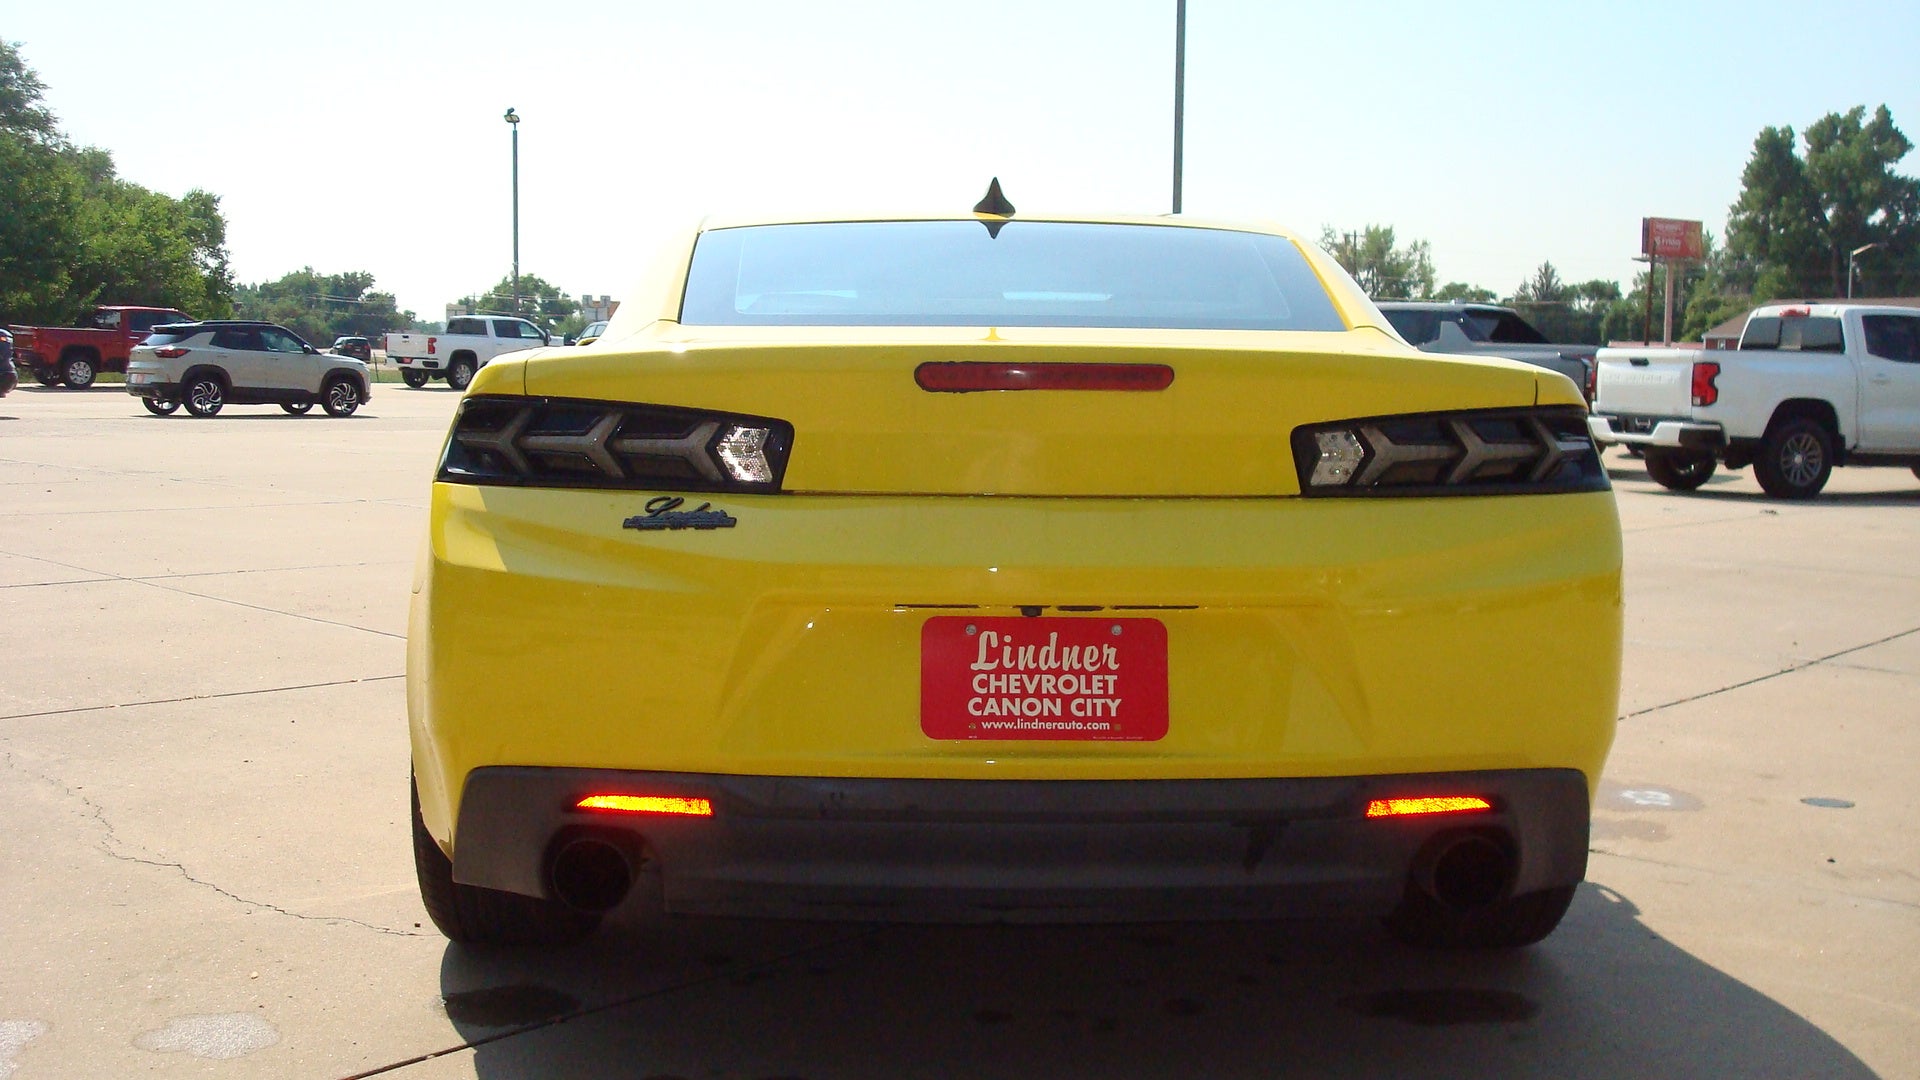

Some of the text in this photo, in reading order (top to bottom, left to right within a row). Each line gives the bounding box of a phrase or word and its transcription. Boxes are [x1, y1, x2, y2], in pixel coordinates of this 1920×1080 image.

[970, 631, 1119, 671] Lindner
[972, 674, 1118, 695] CHEVROLET
[967, 697, 1122, 717] CANON CITY
[981, 718, 1110, 731] www.lindnerauto.com
